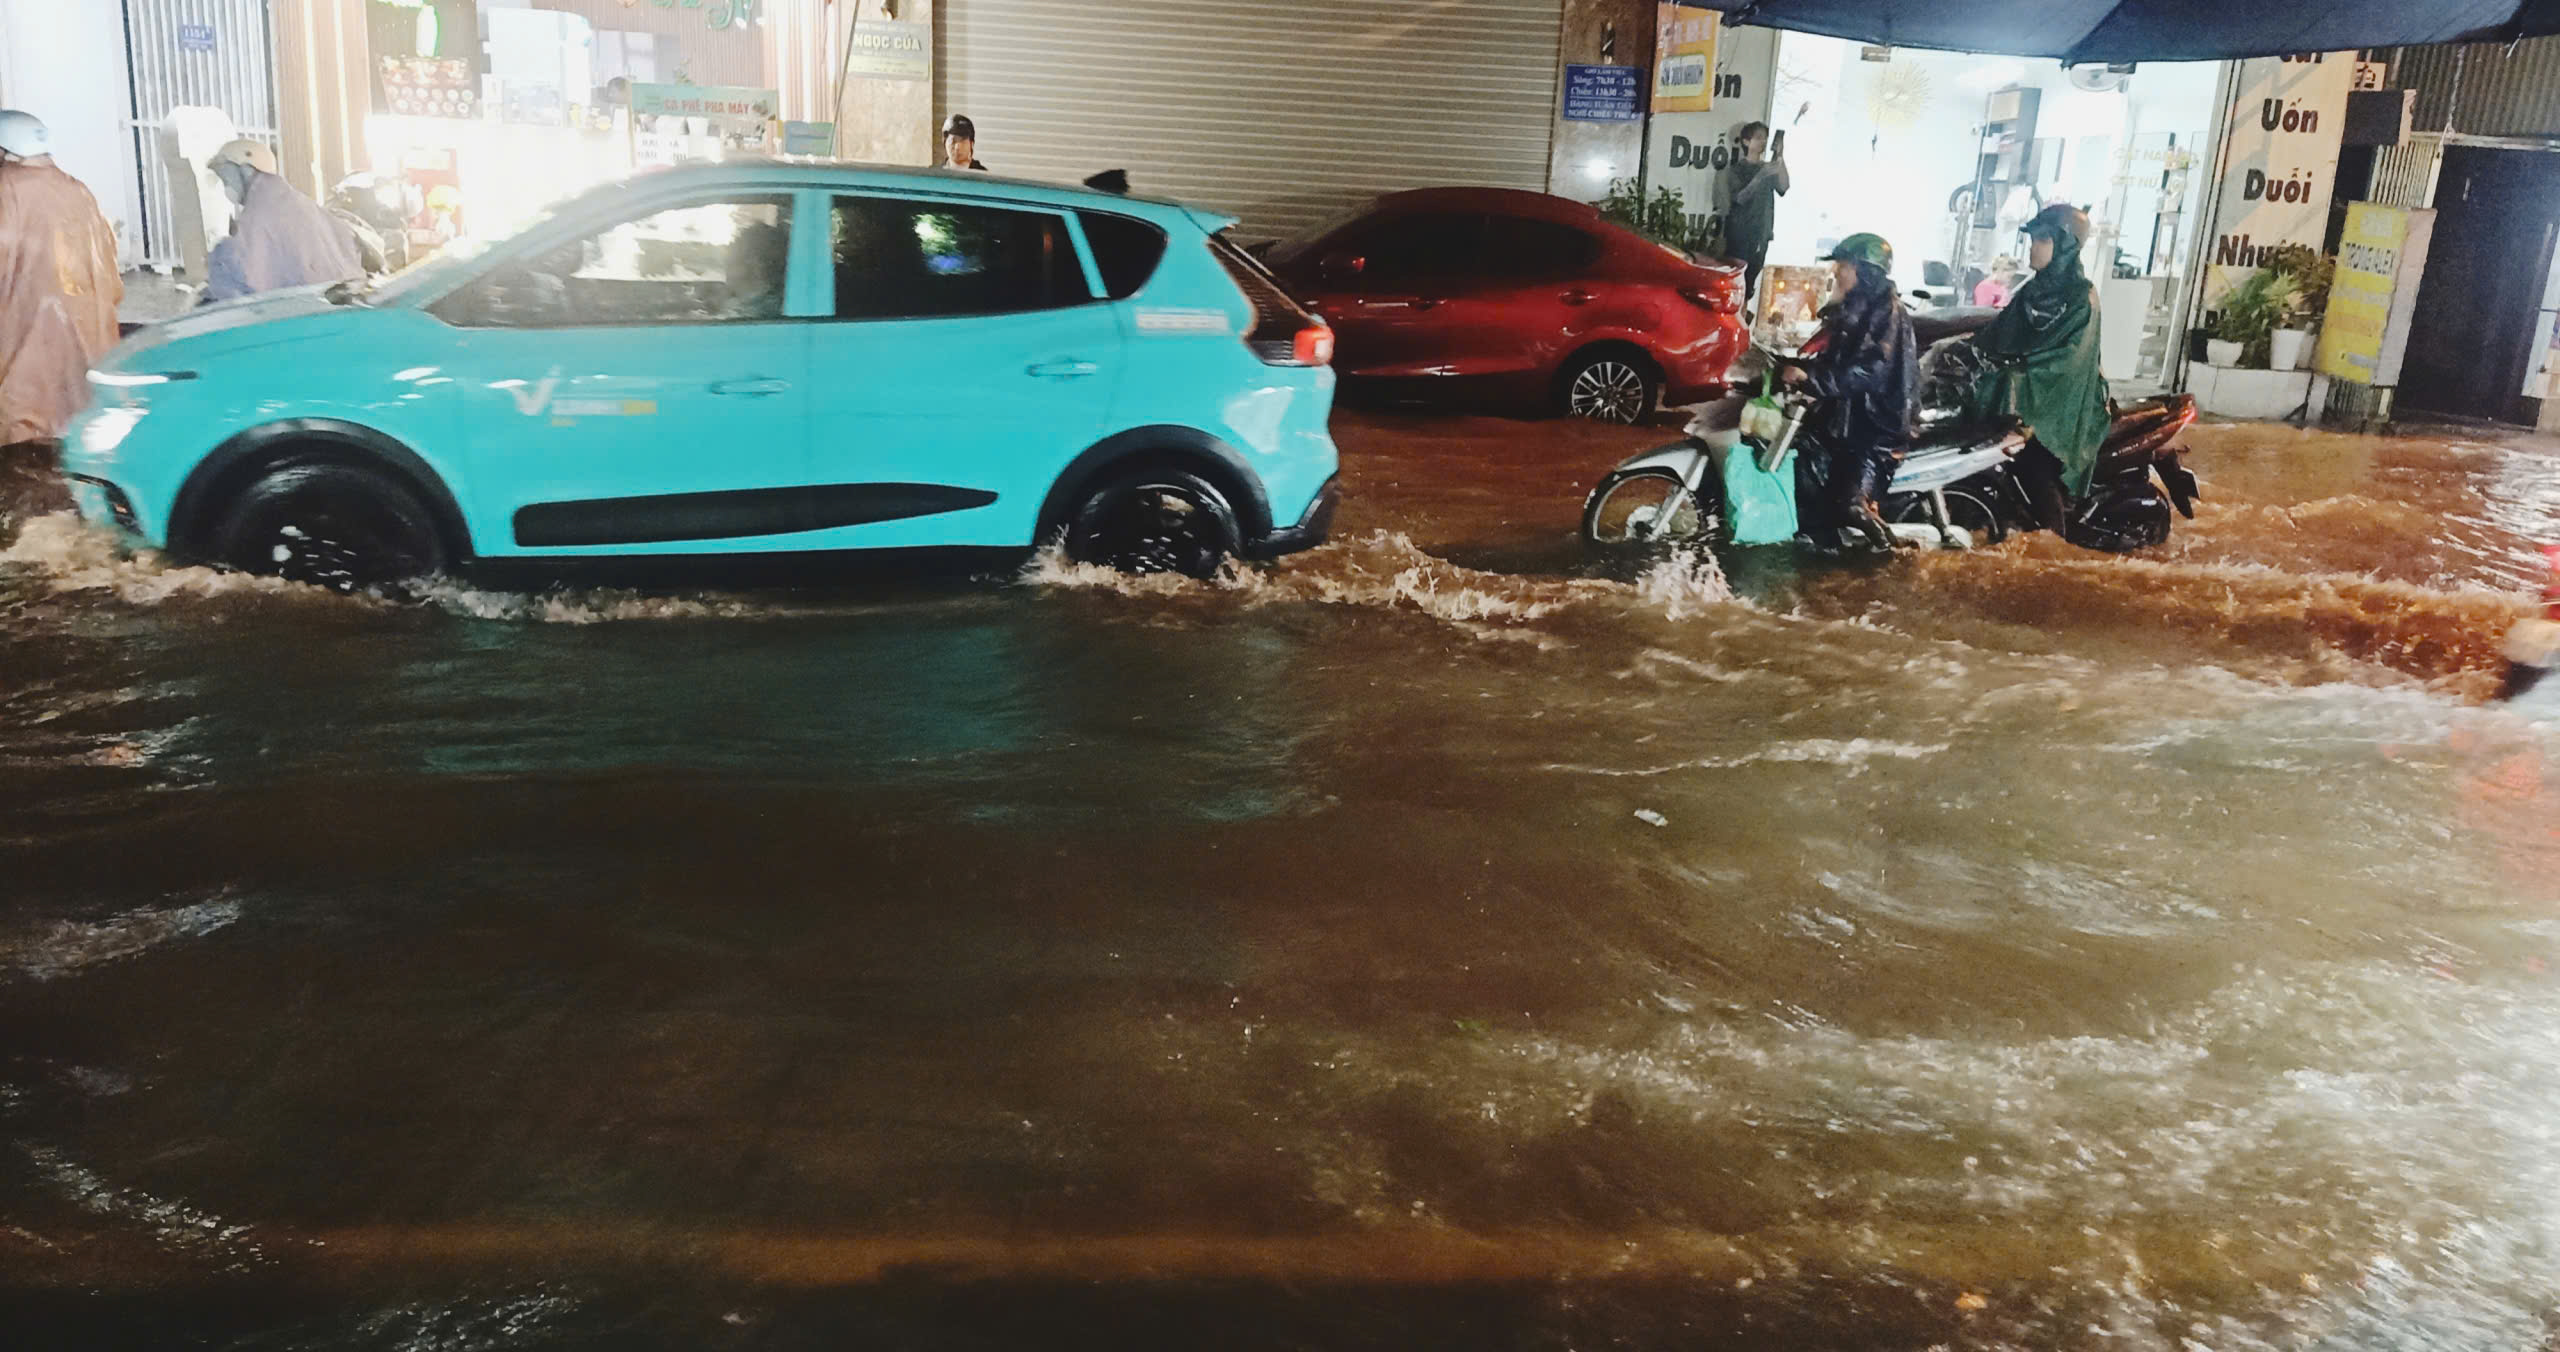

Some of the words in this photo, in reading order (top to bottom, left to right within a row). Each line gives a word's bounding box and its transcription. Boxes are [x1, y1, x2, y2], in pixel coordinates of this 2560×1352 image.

[2261, 97, 2318, 133] Uốn
[1669, 131, 1741, 171] Duỗi
[2243, 167, 2313, 204] Duỗi
